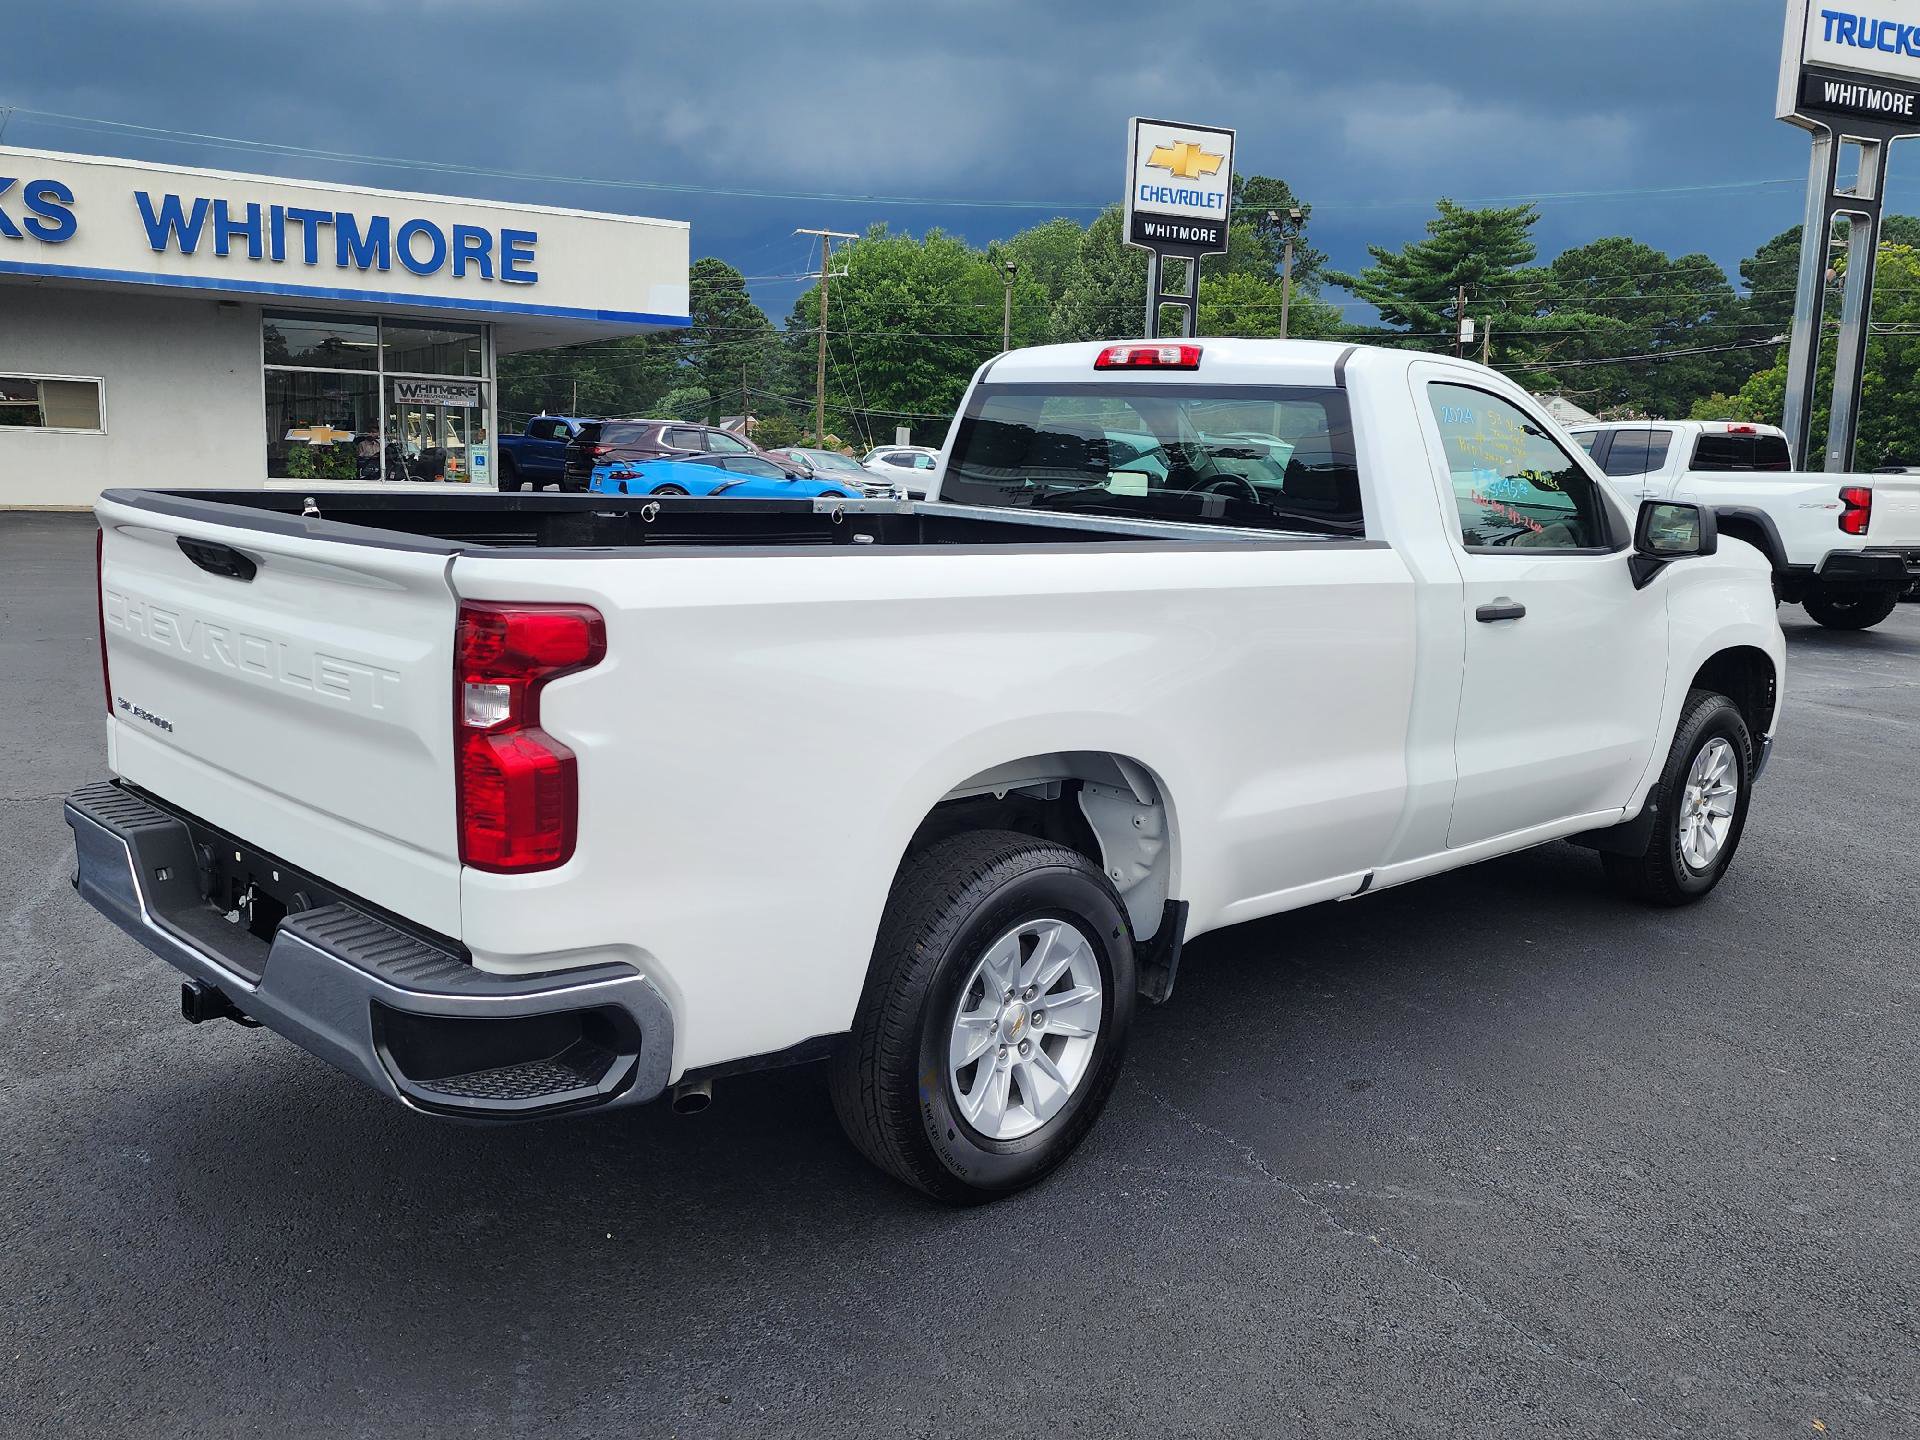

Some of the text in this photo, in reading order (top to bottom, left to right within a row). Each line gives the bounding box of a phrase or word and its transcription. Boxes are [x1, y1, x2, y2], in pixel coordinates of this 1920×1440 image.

[1824, 81, 1915, 115] WHITMORE
[1140, 184, 1225, 209] CHEVROLET
[133, 190, 539, 284] WHITMORE
[1144, 222, 1217, 242] WHITMORE
[398, 383, 477, 398] WHITMORE
[105, 589, 400, 709] CHEVROLET
